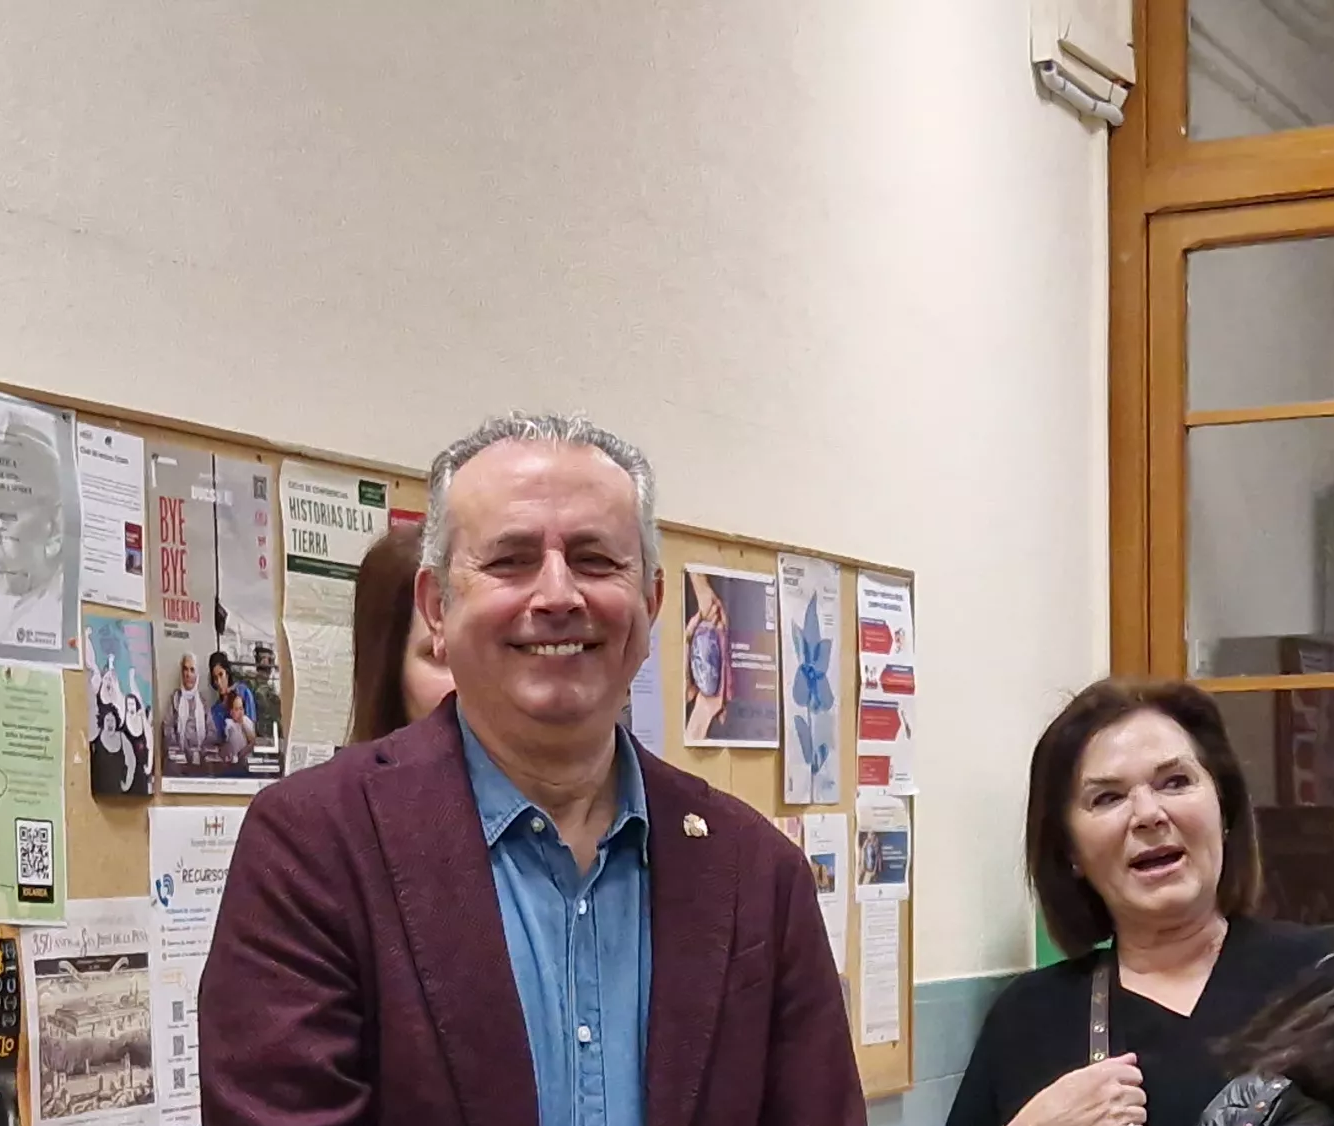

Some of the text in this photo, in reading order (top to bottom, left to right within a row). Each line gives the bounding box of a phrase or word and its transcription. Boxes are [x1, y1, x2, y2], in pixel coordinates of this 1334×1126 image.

[158, 496, 187, 546] BYE
[289, 497, 374, 534] HISTORIAS DE LA
[292, 528, 328, 556] TIERRA
[161, 547, 188, 596] BYE
[162, 597, 201, 624] TIBERIAS
